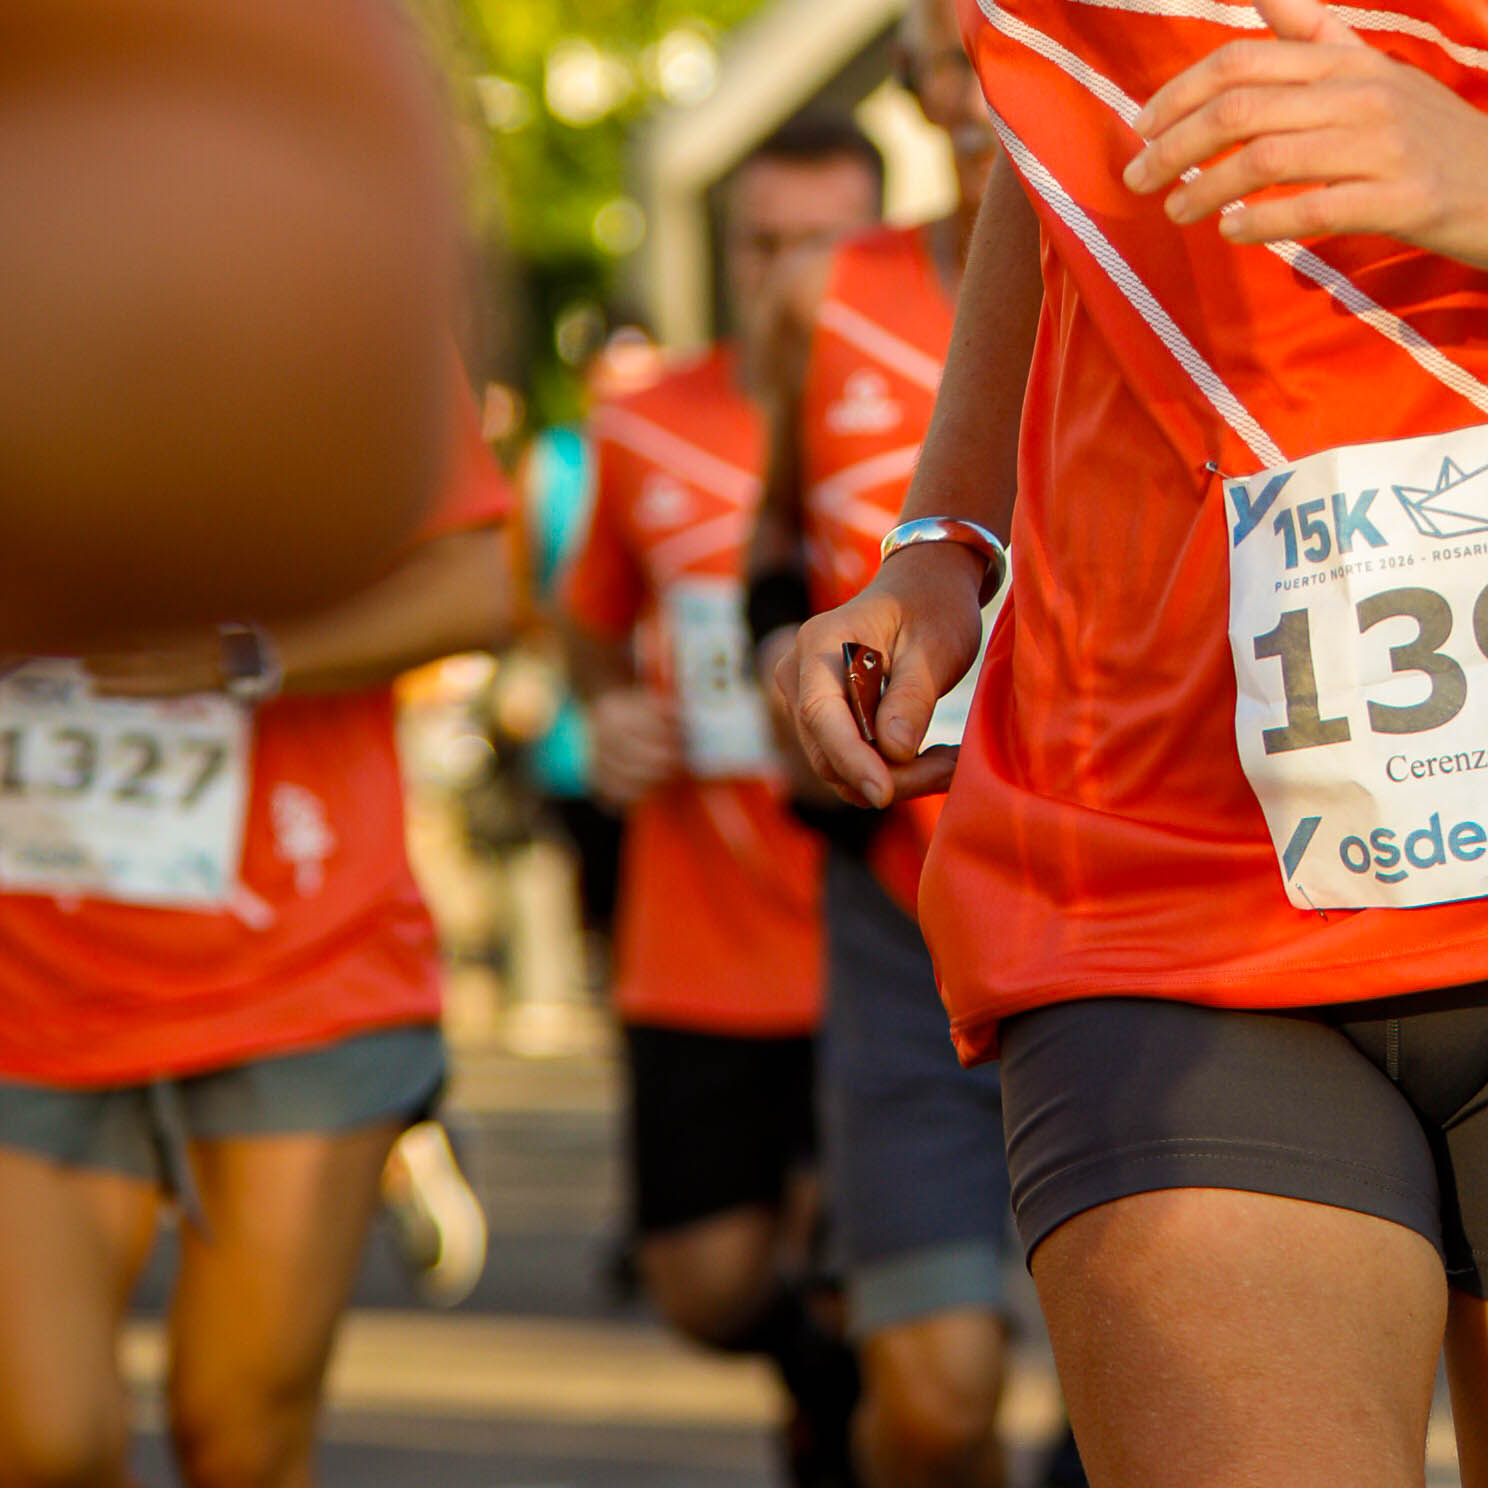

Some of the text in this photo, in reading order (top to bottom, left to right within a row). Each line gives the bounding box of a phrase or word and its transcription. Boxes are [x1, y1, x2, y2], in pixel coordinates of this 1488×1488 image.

[1273, 488, 1389, 571] 15K
[1274, 571, 1327, 593] PUERTO
[1330, 559, 1374, 581] NORTE
[1380, 553, 1415, 571] 2026
[0, 726, 227, 813] 1327
[1339, 811, 1488, 876] osde
